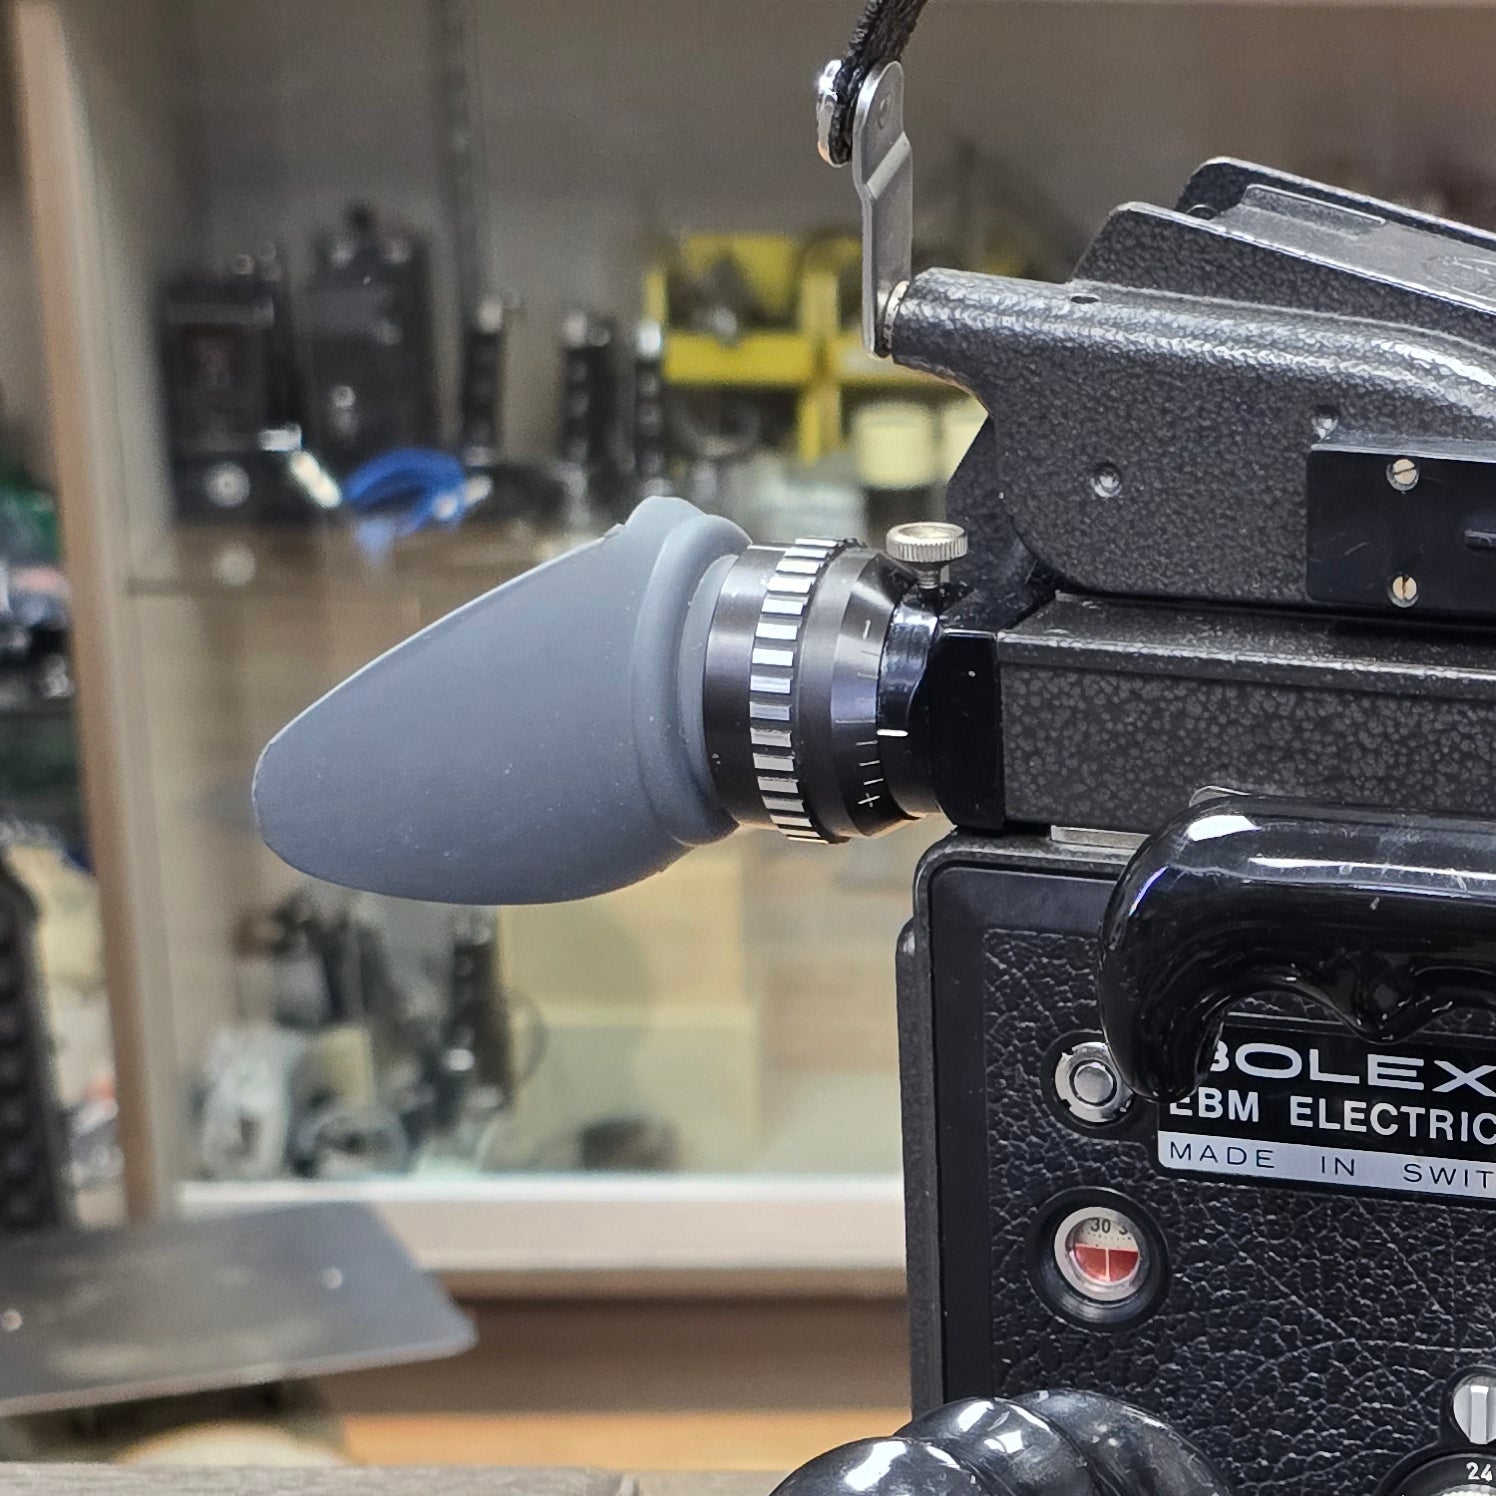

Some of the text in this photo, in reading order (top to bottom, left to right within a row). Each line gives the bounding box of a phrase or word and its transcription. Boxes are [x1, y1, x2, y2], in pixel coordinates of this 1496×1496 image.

[1169, 1141, 1276, 1169] MADE
[1321, 1155, 1356, 1177] IN
[1091, 1217, 1111, 1233] 30
[1466, 1461, 1493, 1482] 24
